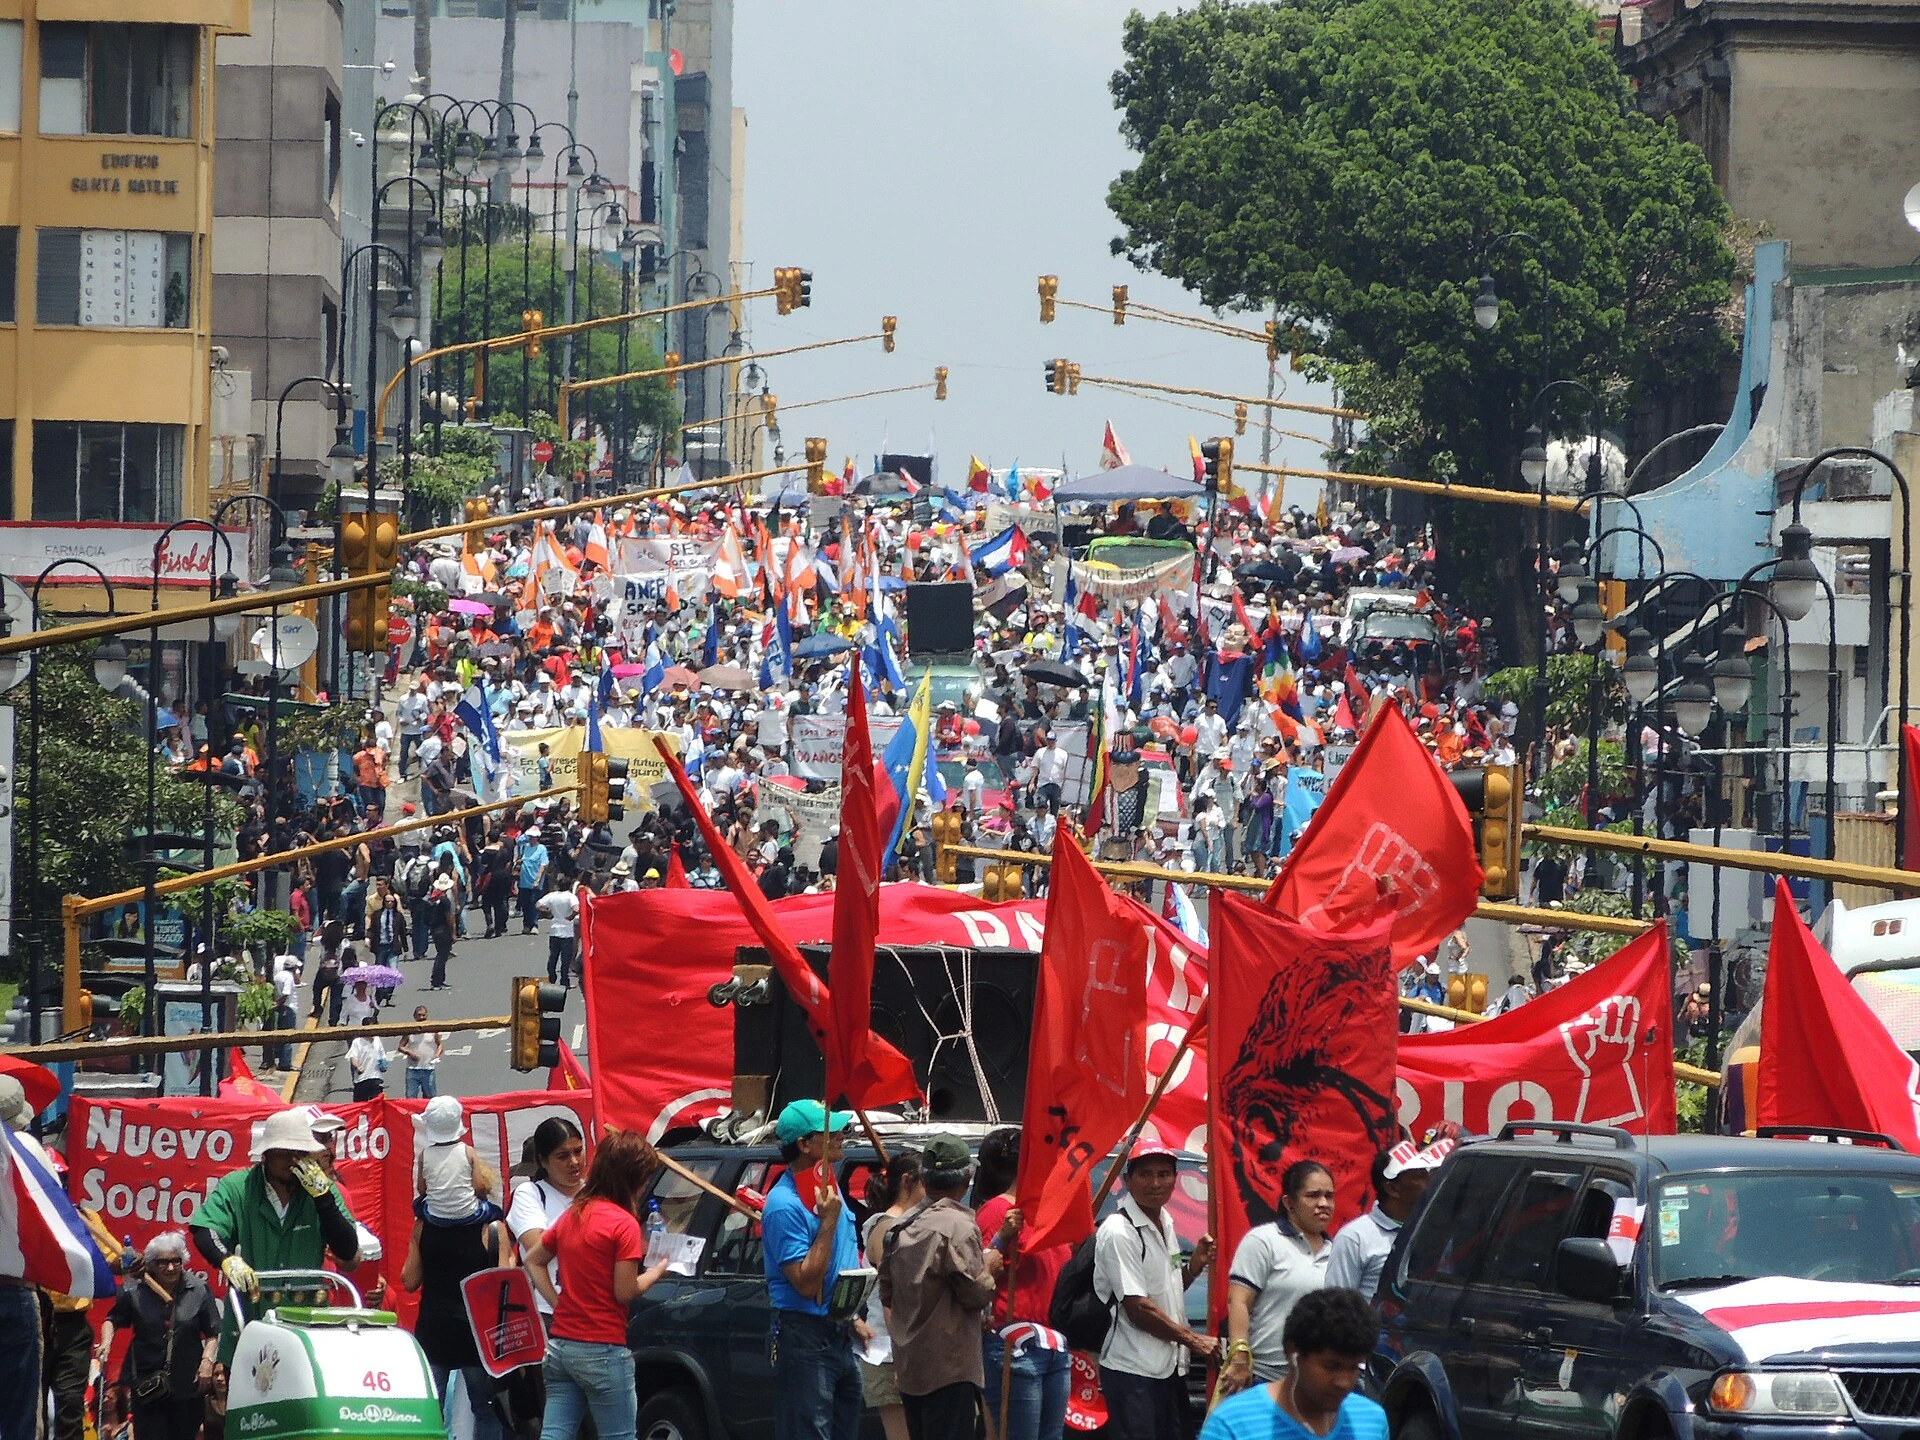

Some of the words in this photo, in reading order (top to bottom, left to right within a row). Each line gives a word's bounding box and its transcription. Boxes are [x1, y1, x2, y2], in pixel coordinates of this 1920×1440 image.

[71, 177, 121, 193] SANTA
[44, 544, 106, 558] FARMACIA
[281, 624, 303, 635] SKY
[86, 1105, 233, 1163] Nuevo
[362, 1370, 392, 1393] 46
[338, 1406, 366, 1422] Dos
[381, 1406, 422, 1423] Pinos
